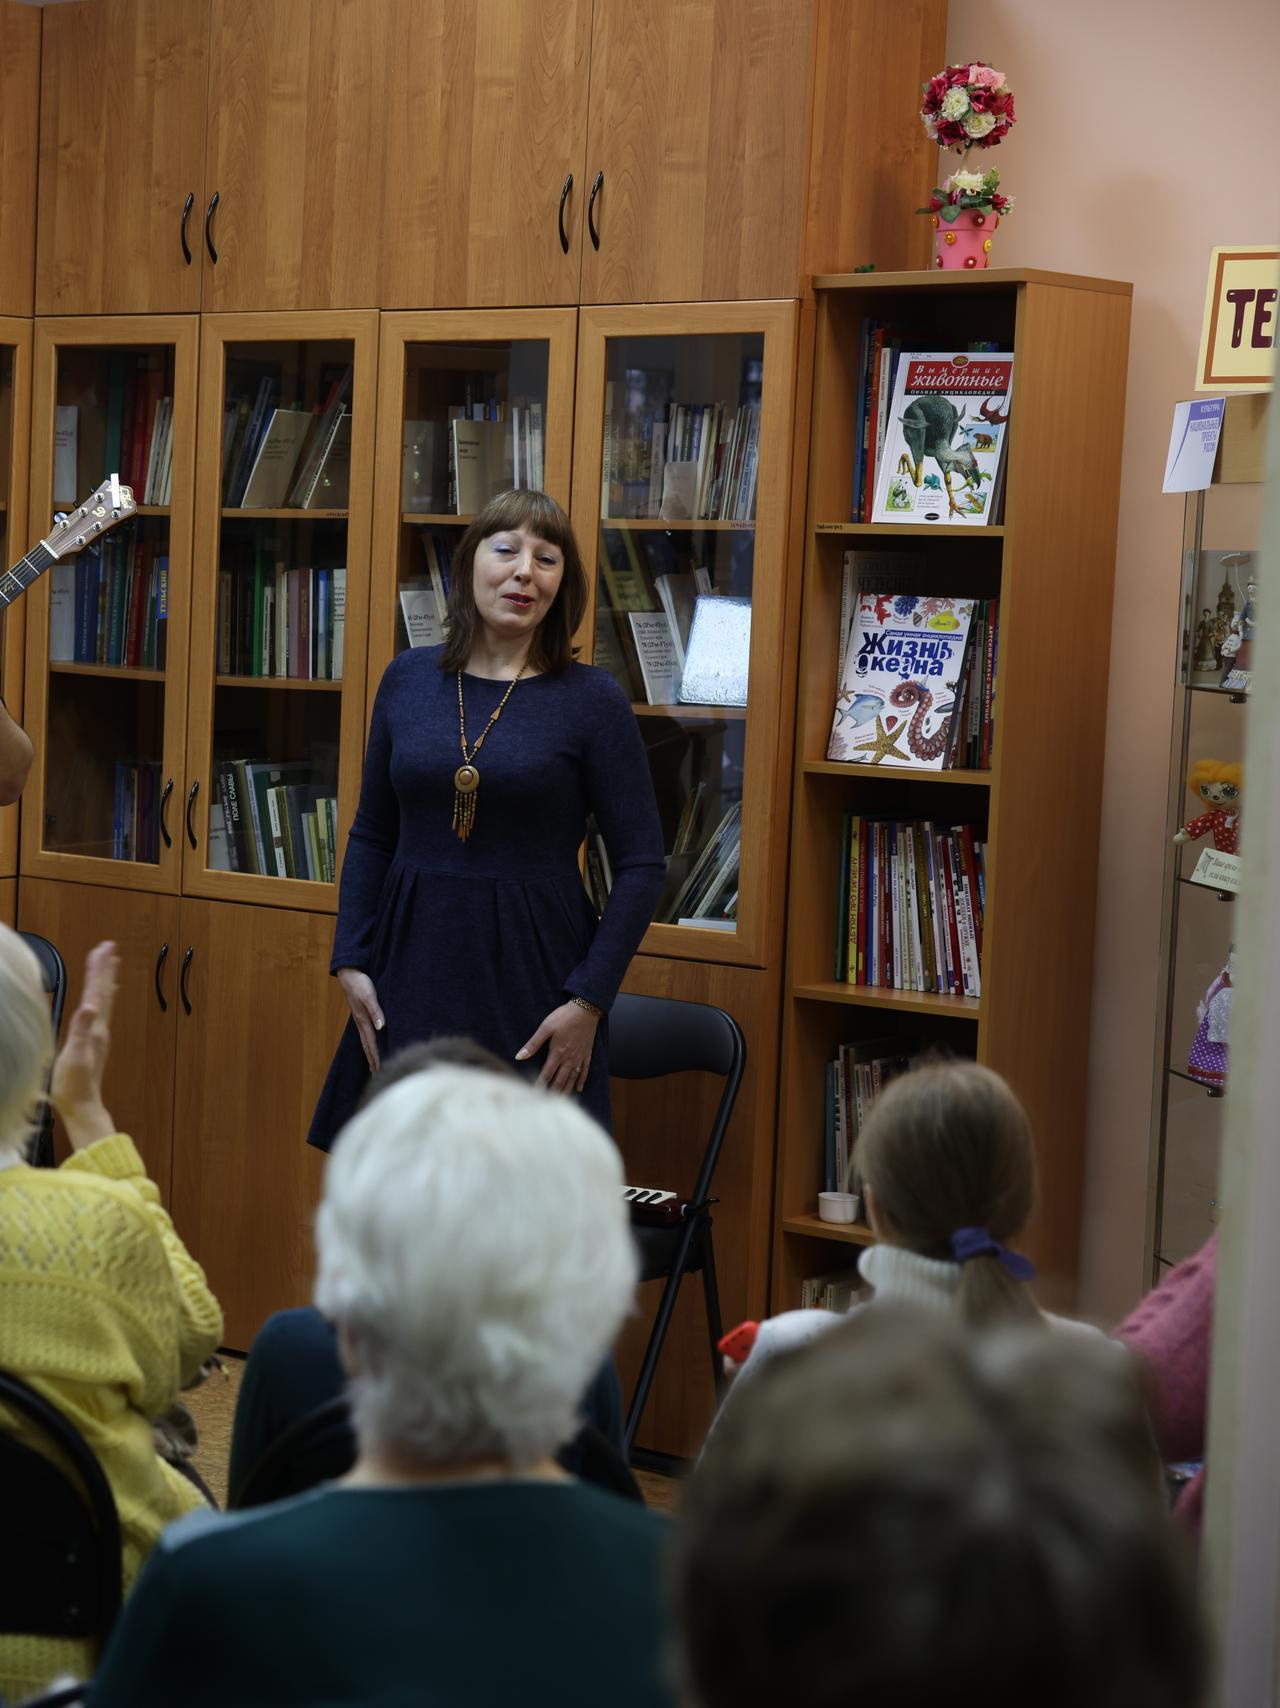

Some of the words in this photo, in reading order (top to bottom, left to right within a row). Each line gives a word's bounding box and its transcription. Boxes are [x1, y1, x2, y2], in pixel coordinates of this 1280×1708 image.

[911, 373, 1004, 387] животные
[916, 365, 1001, 376] Вымершие
[858, 631, 953, 660] Жизнь
[227, 773, 237, 800] СЛАВЫ
